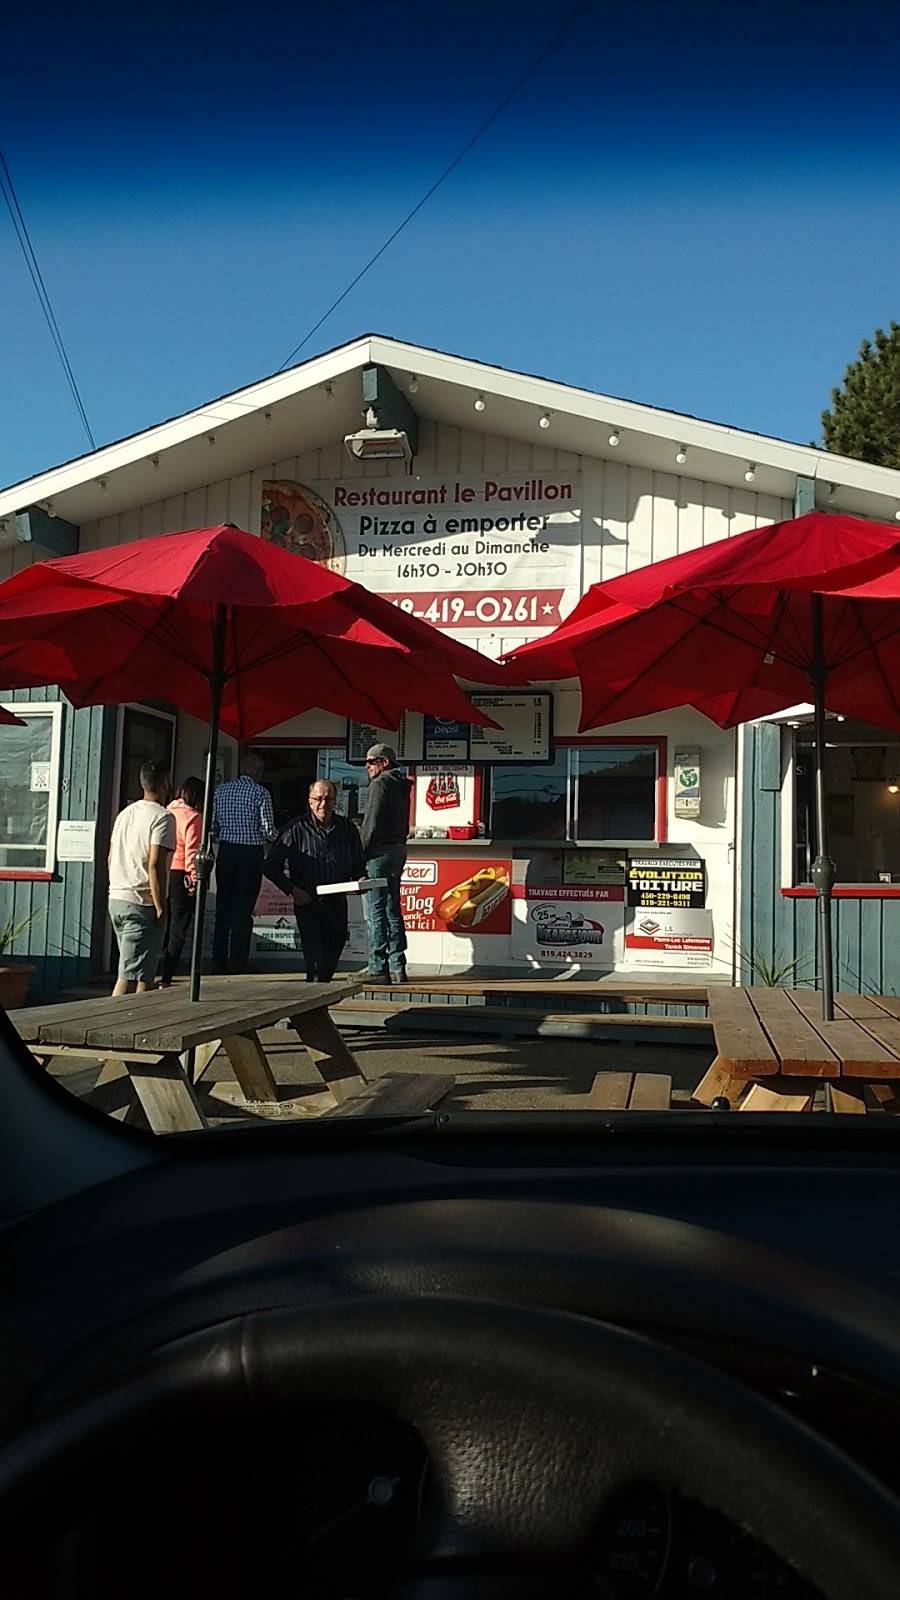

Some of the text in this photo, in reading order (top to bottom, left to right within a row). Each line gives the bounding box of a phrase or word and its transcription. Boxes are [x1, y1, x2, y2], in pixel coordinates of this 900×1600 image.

[334, 480, 572, 507] Restaurant le Pavillon
[360, 513, 549, 537] Pizza à emporter
[358, 540, 550, 557] Du Mercredi au Dimanche
[397, 563, 440, 578] 16h30
[456, 562, 507, 577] 20h30
[434, 725, 459, 735] pepsi
[629, 879, 704, 892] TOITURE
[528, 888, 609, 898] TRAVAUX EFFECTUÉS PAR
[537, 911, 549, 921] 25
